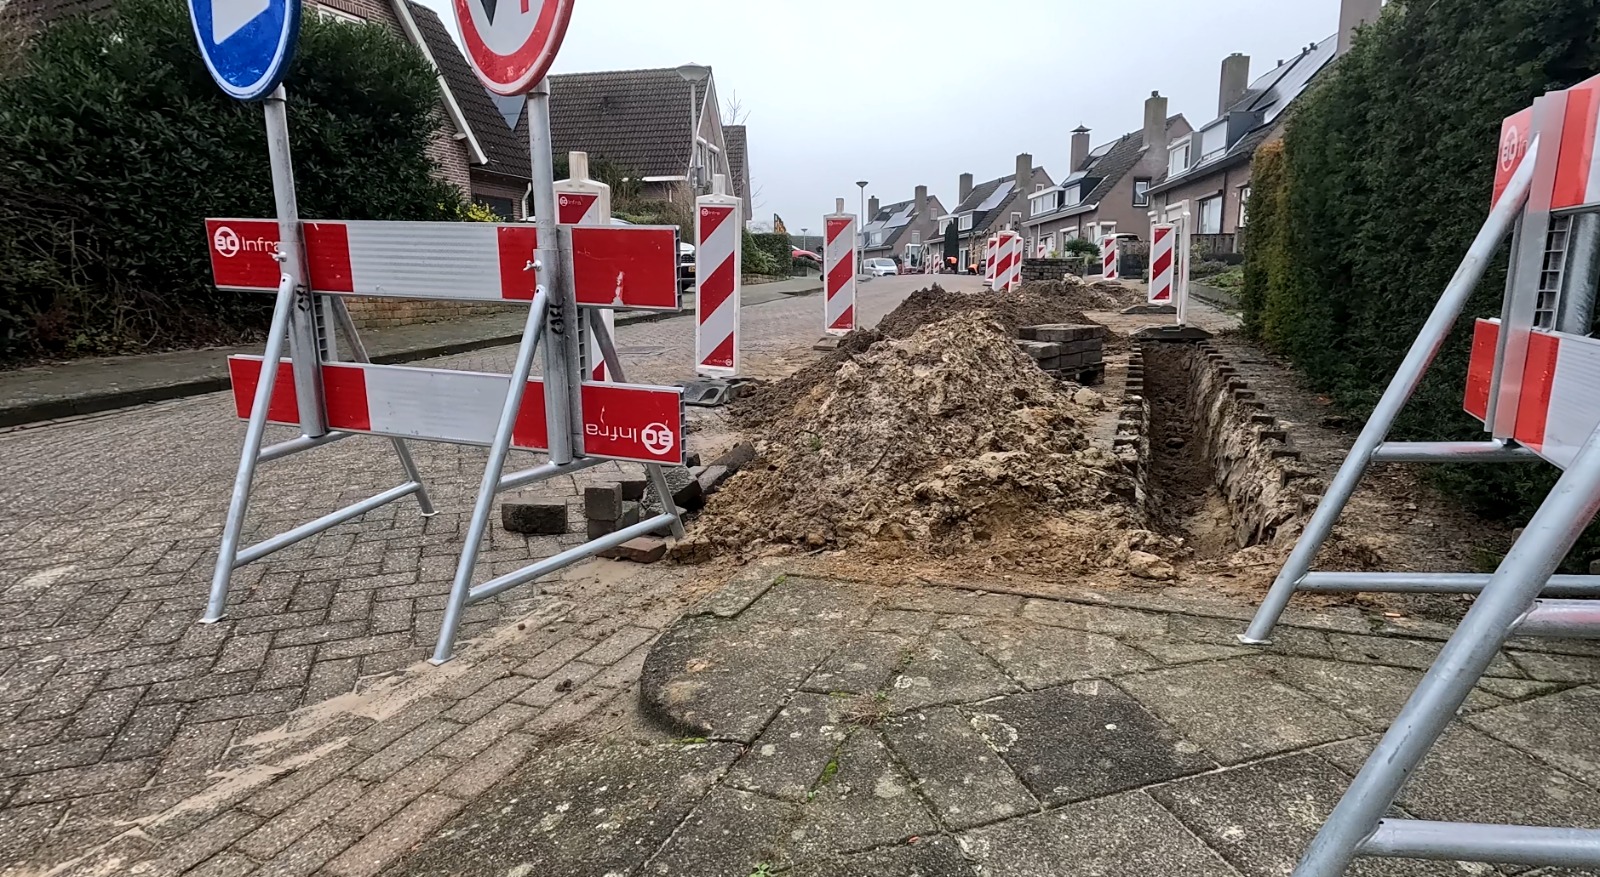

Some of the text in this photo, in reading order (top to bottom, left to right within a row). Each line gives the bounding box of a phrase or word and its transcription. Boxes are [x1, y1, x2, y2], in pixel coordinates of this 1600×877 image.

[214, 231, 240, 254] BO
[585, 423, 673, 451] BO Infra
